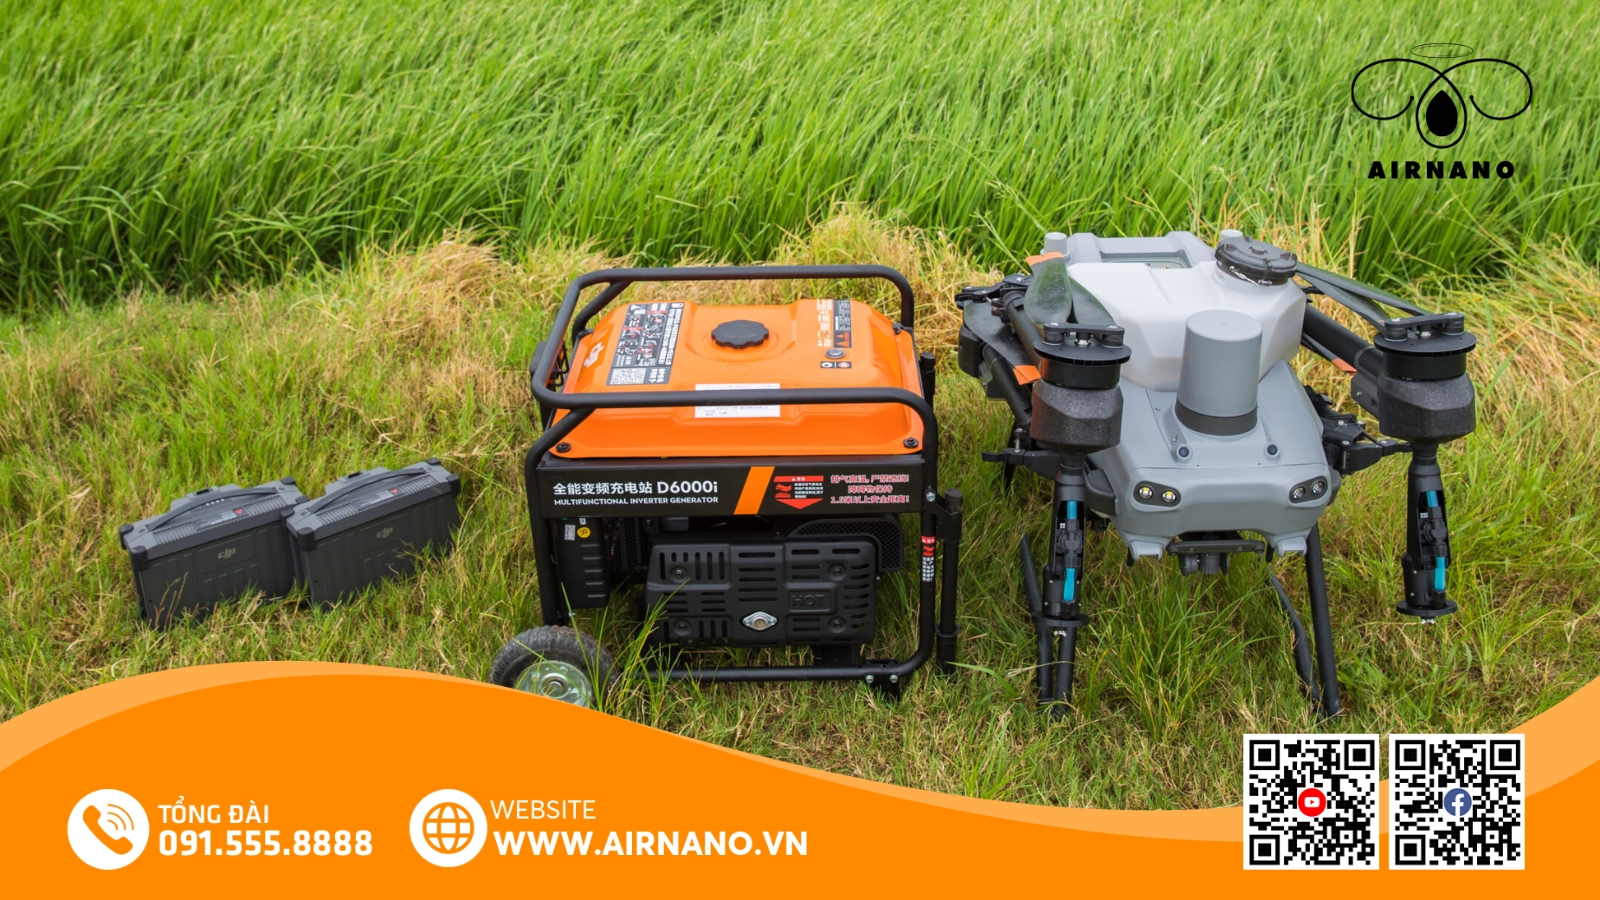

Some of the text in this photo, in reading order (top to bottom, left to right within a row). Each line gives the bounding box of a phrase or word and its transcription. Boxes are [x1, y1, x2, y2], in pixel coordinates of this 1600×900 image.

[553, 481, 718, 496] 全能变频充电站 D6000i
[554, 498, 629, 506] MULTIFUNCTIONAL
[670, 496, 719, 504] GENERATOR
[791, 594, 826, 607] HOT
